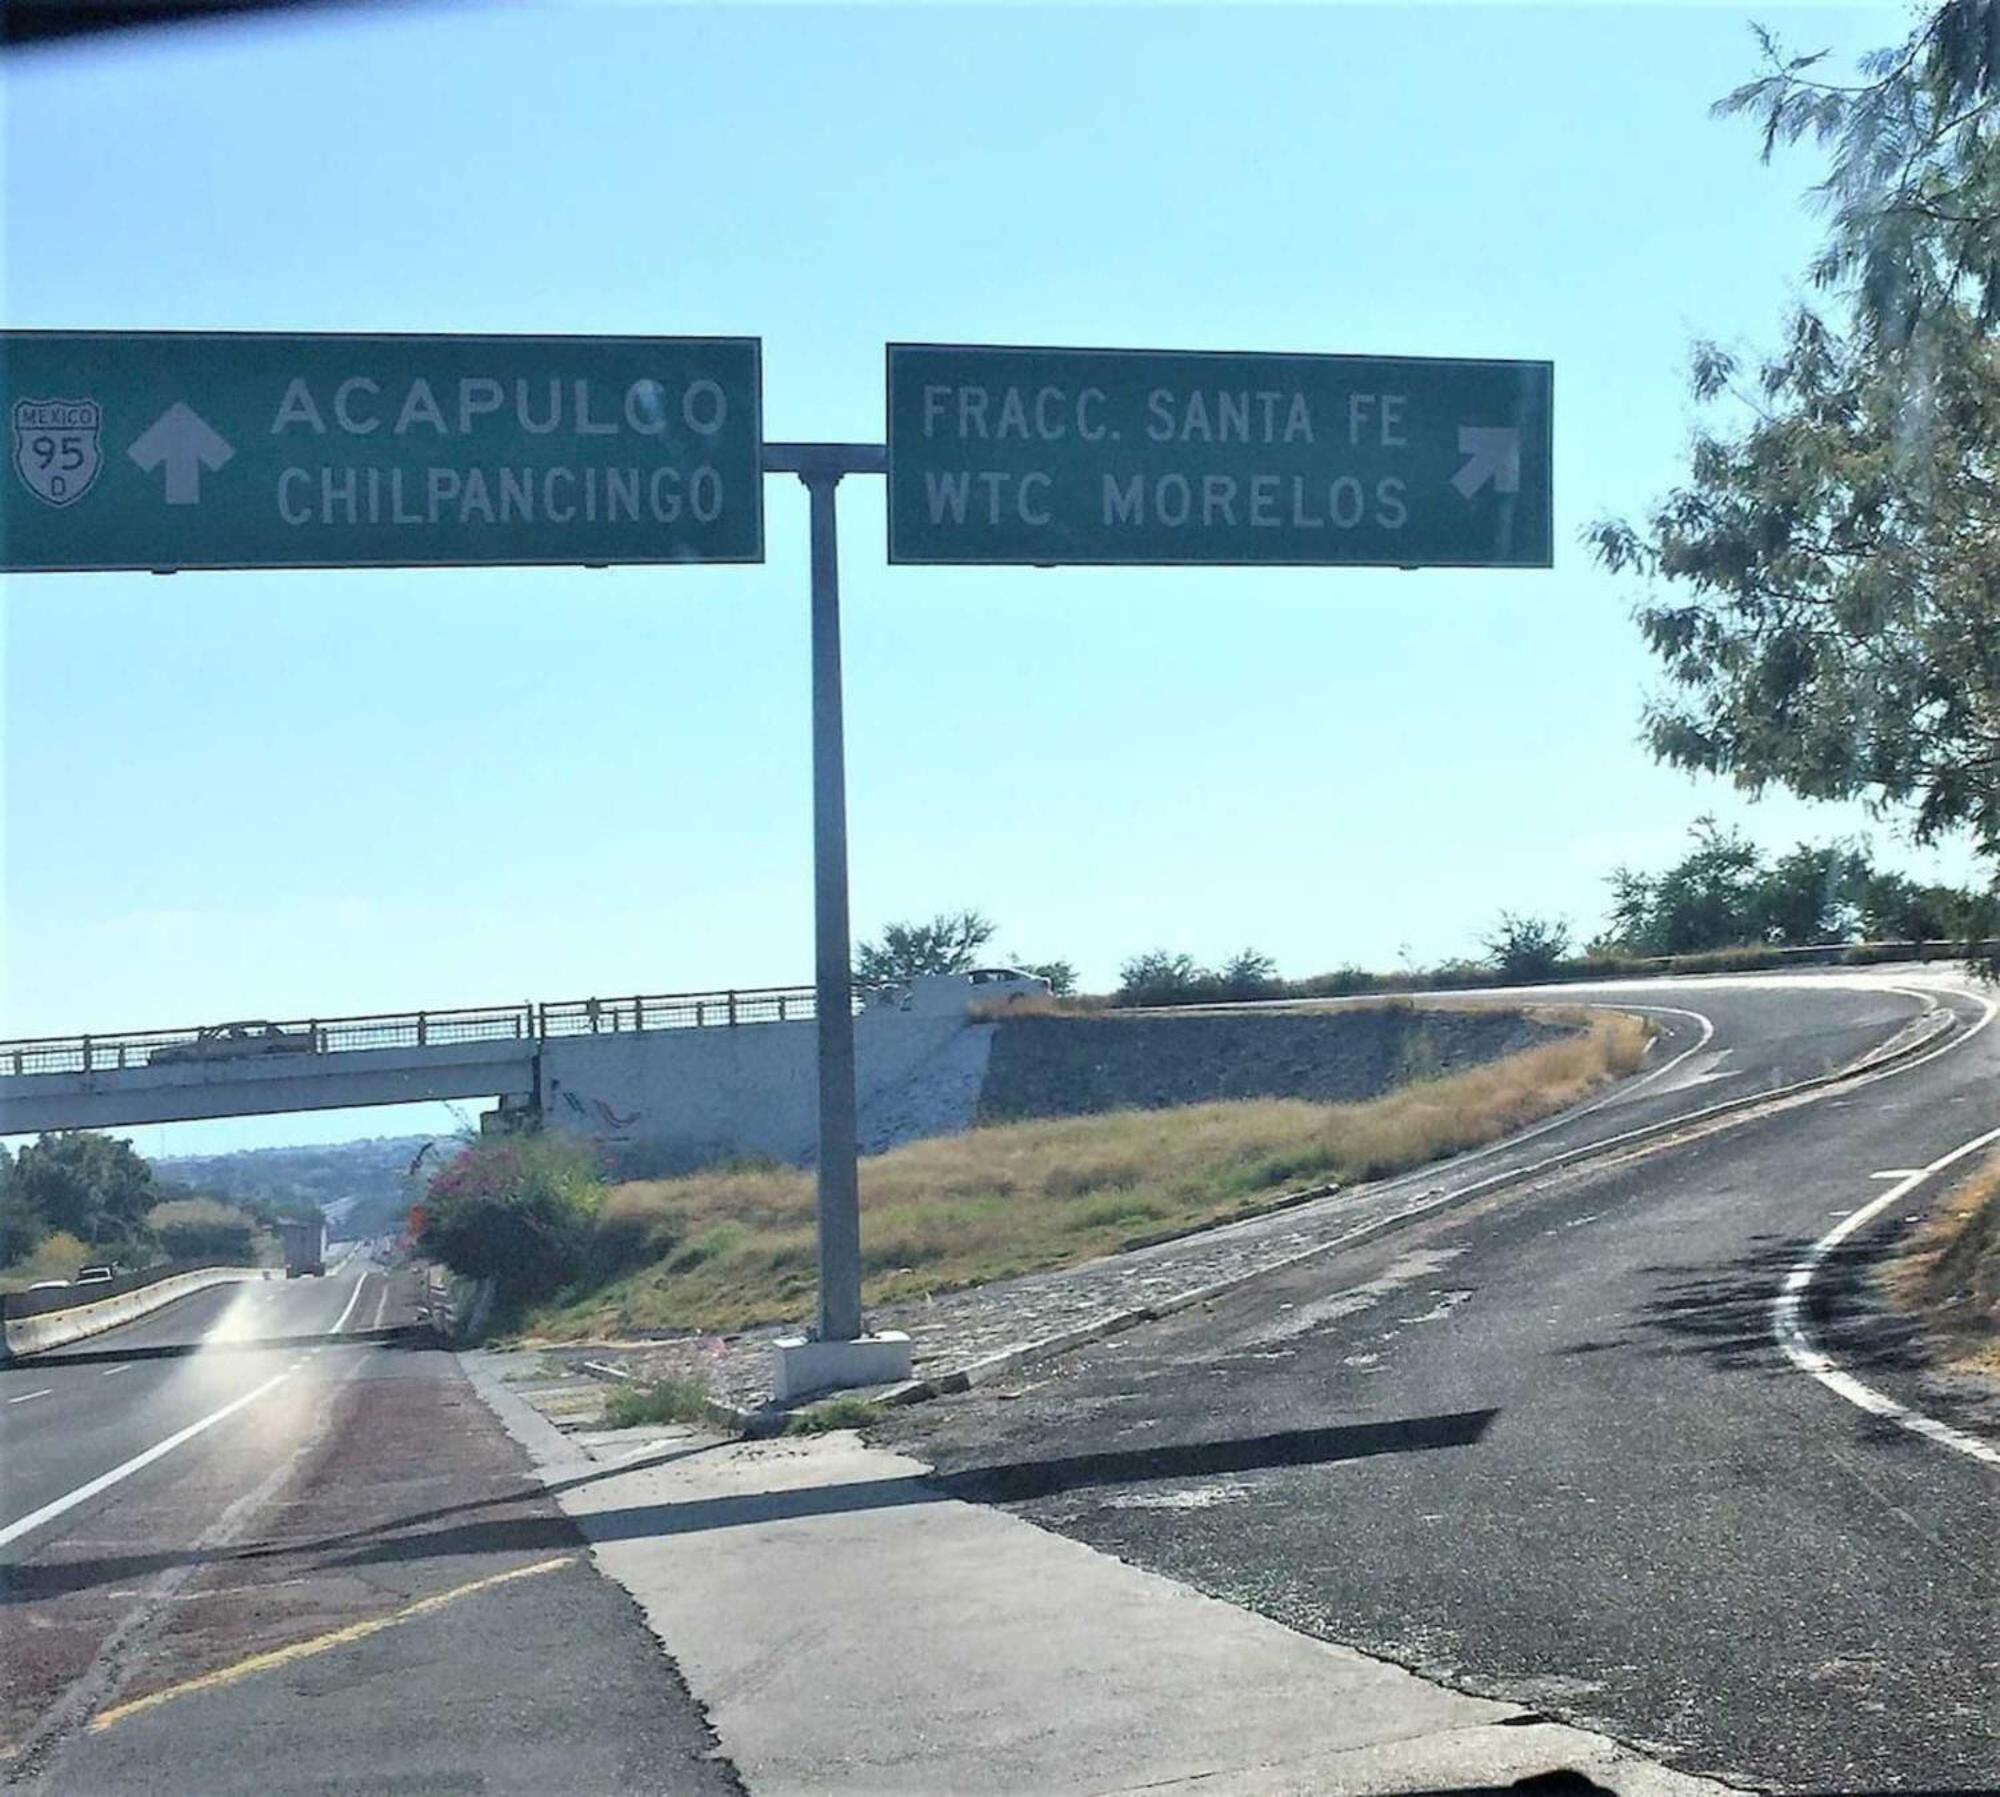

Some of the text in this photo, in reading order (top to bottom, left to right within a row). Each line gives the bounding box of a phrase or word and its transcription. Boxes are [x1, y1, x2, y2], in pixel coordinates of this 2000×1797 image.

[22, 408, 93, 425] MEXICO
[270, 377, 728, 437] ACAPULCO
[923, 385, 1407, 446] FRACC. SANTA FE
[32, 436, 84, 470] 95
[277, 466, 724, 526] CHILPANCINGO
[925, 472, 1408, 529] WTC MORELOS
